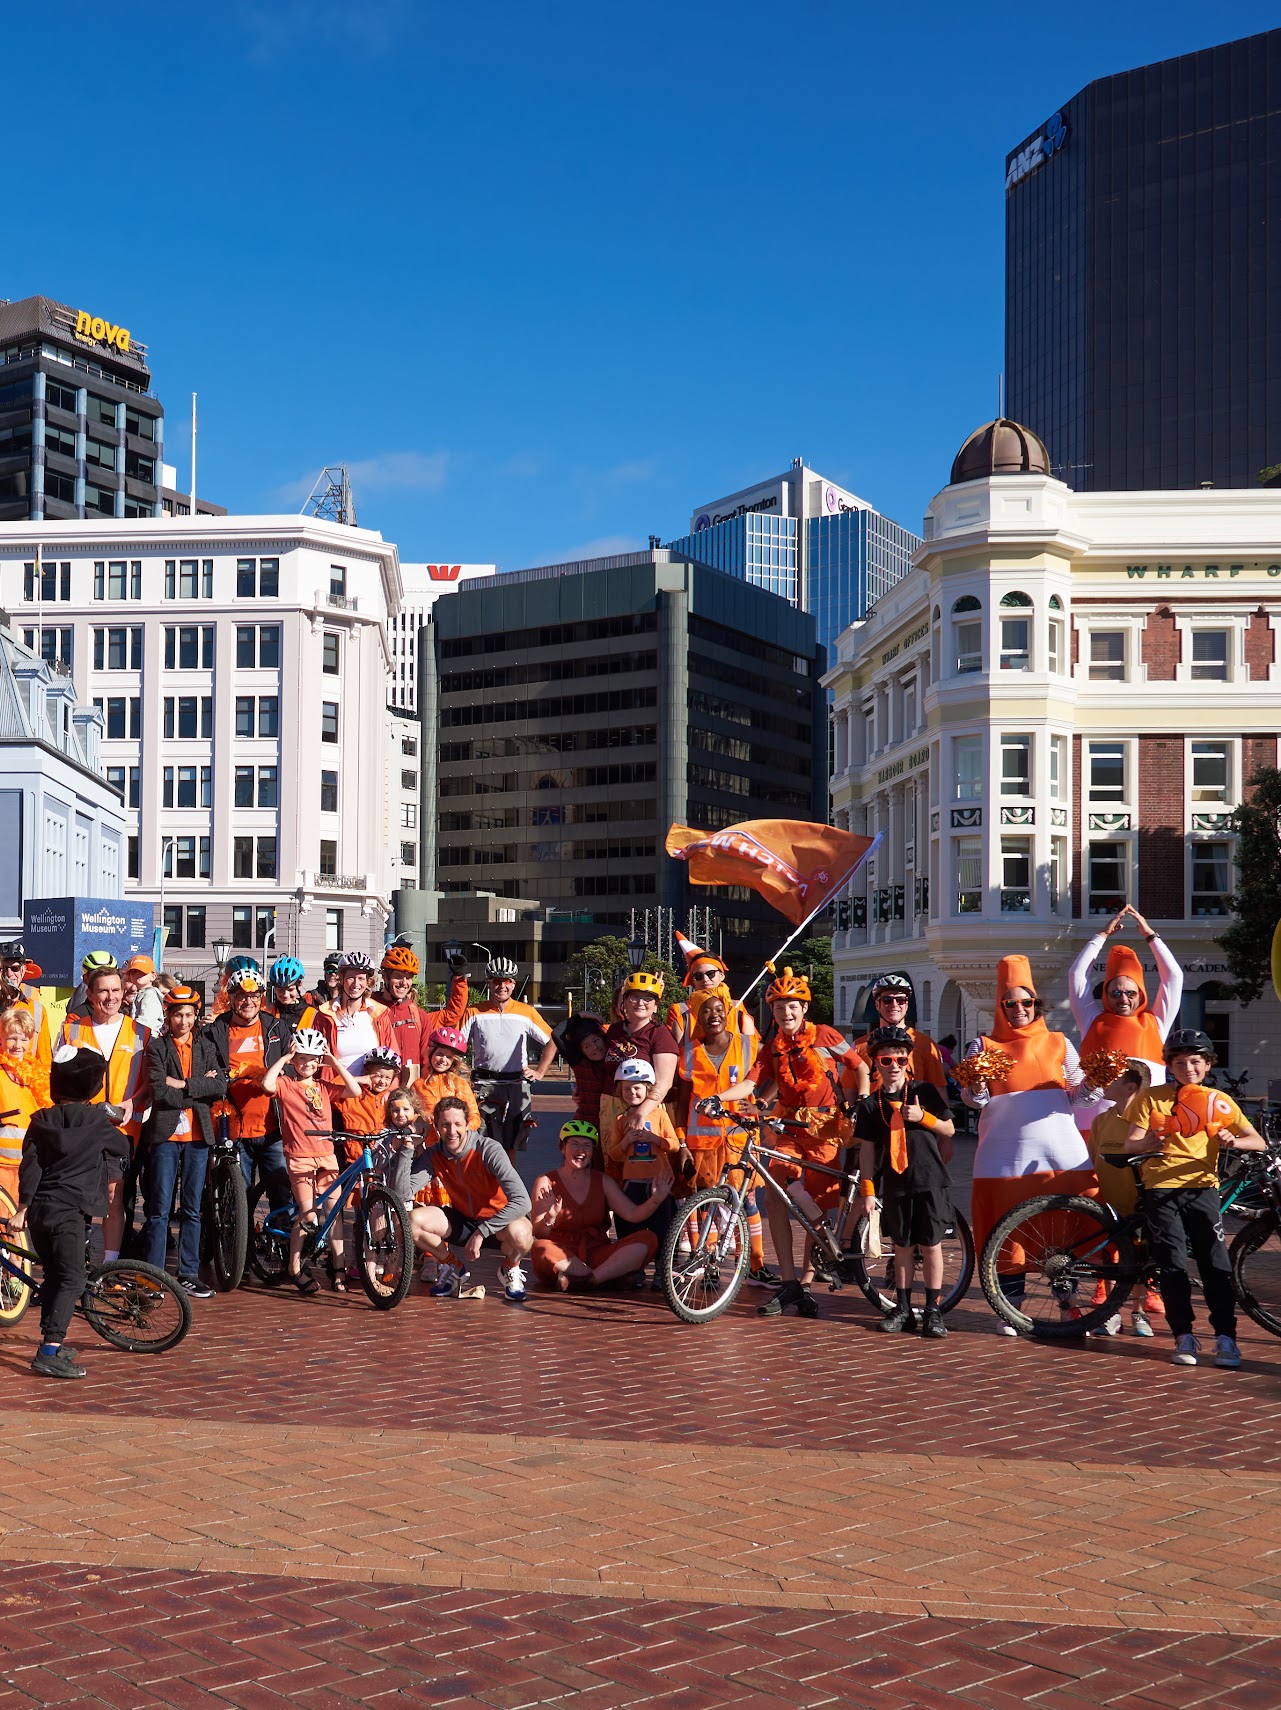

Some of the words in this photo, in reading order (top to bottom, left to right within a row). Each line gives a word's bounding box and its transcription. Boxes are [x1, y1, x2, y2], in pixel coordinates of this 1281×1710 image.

[1006, 136, 1045, 190] ANZ
[76, 309, 131, 353] nova
[75, 332, 97, 348] energy
[736, 496, 777, 516] Thornton
[1126, 564, 1244, 579] WHARF
[30, 914, 66, 925] Wellington
[81, 912, 126, 926] Wellington
[30, 924, 58, 933] Museum
[81, 923, 116, 934] Museum
[1091, 963, 1106, 973] NE
[1182, 963, 1232, 973] ACADEM
